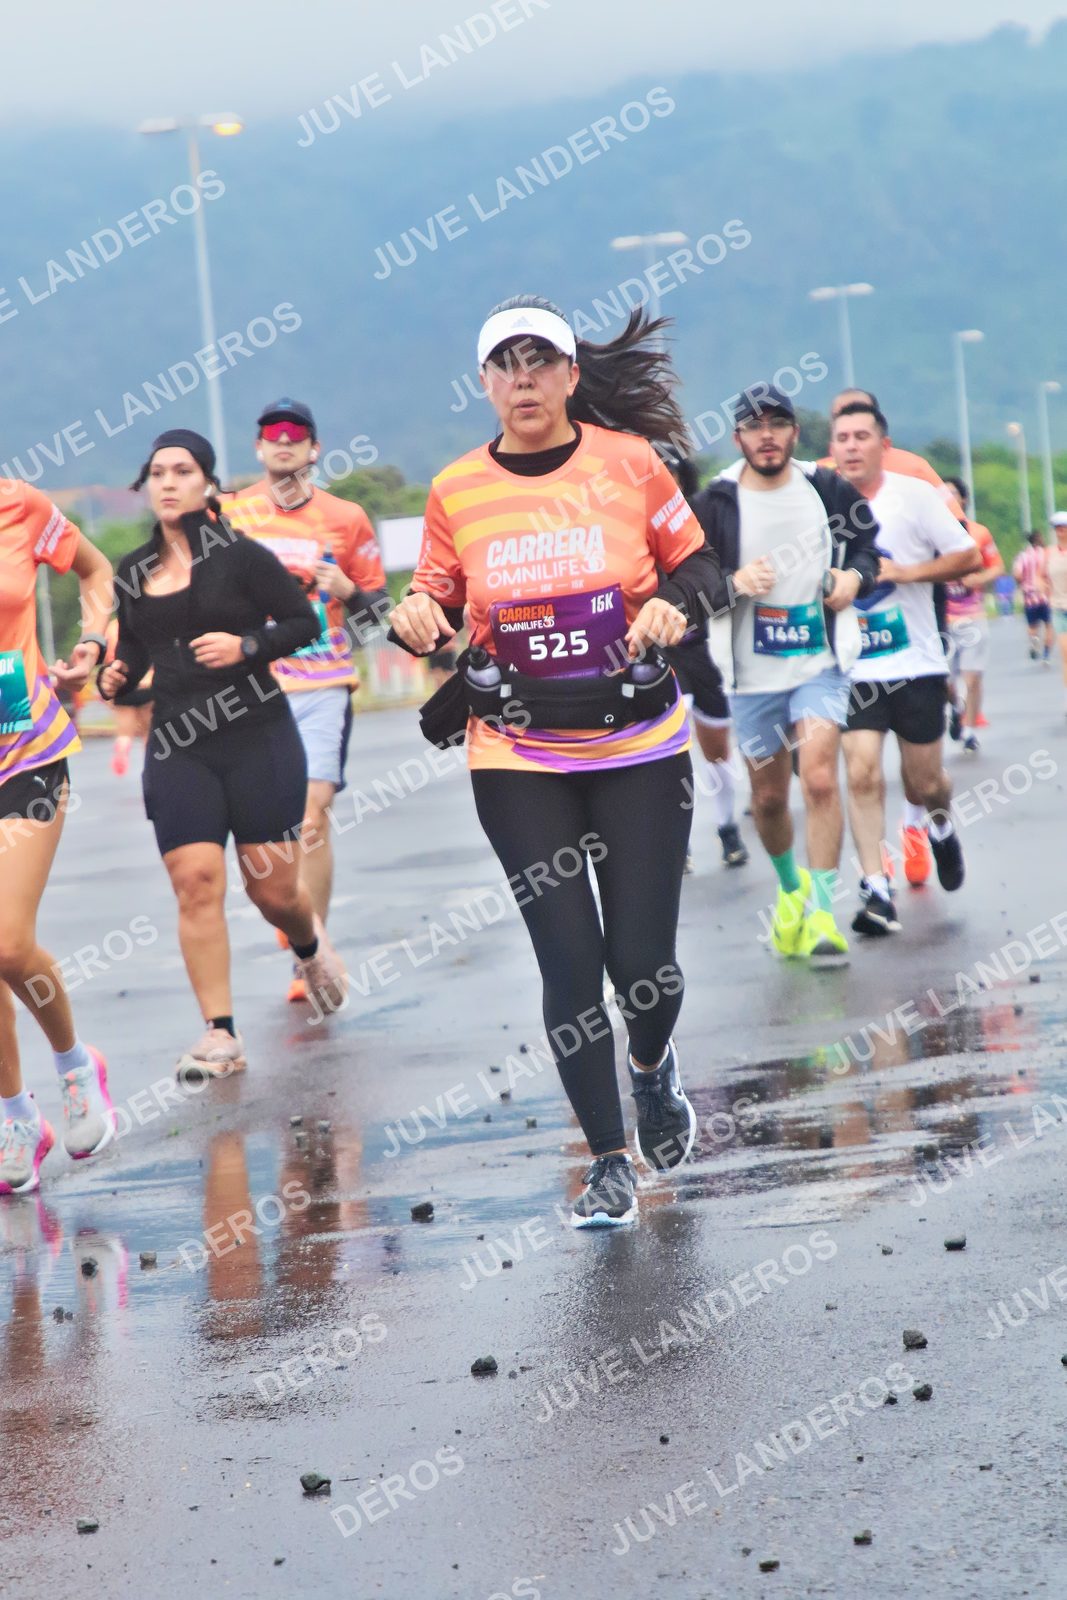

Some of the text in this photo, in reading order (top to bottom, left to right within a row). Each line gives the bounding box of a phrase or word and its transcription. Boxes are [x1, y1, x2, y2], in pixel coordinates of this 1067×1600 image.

[487, 524, 604, 569] CARRERA
[486, 557, 580, 588] OMNILIFE
[498, 604, 555, 623] CARRERA
[500, 619, 543, 633] OMNILIFE
[528, 629, 590, 661] 525
[764, 625, 810, 643] 1445
